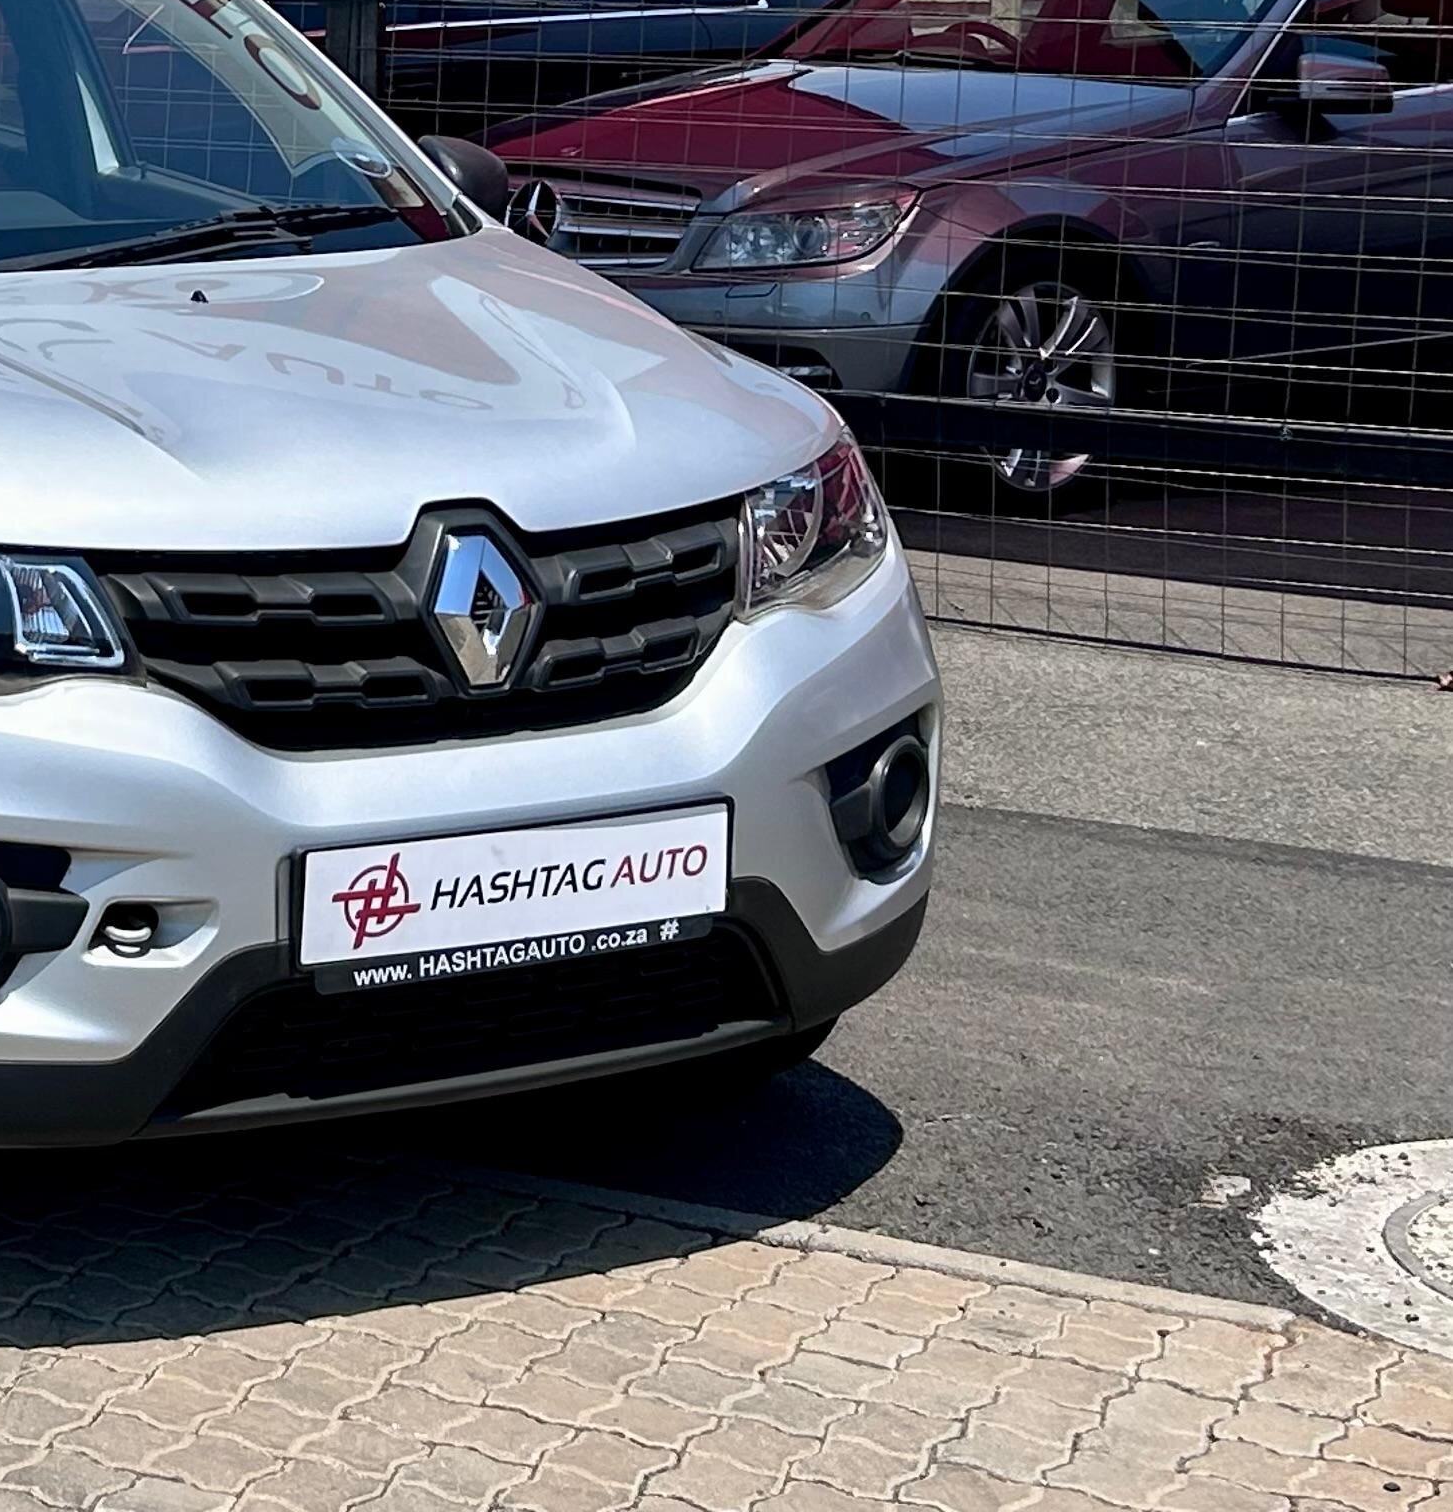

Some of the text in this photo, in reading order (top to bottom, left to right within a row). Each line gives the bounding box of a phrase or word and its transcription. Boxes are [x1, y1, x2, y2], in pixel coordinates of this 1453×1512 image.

[431, 845, 707, 910] HASHTAG AUTO
[353, 964, 412, 986] www.
[419, 934, 585, 977] HASHTAGAUTO
